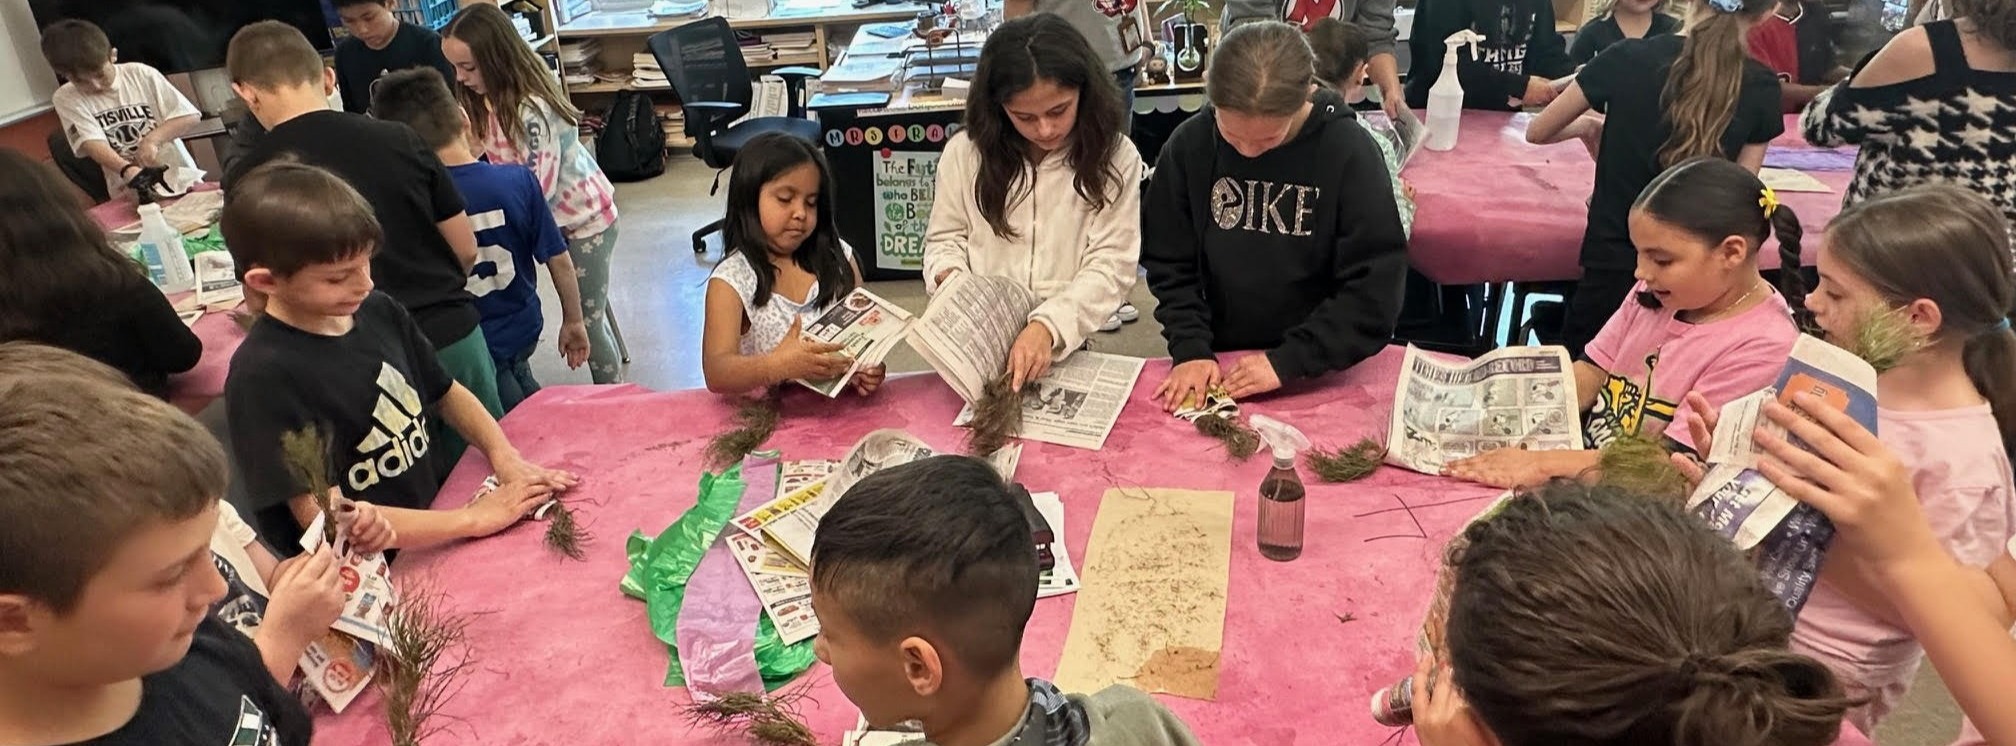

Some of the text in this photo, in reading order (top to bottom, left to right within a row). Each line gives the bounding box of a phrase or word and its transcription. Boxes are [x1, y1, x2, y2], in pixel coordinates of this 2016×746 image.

[828, 128, 880, 144] MRS
[882, 160, 905, 174] The
[876, 174, 916, 187] belongs
[883, 189, 908, 200] who
[911, 220, 927, 233] th
[464, 209, 516, 297] 5
